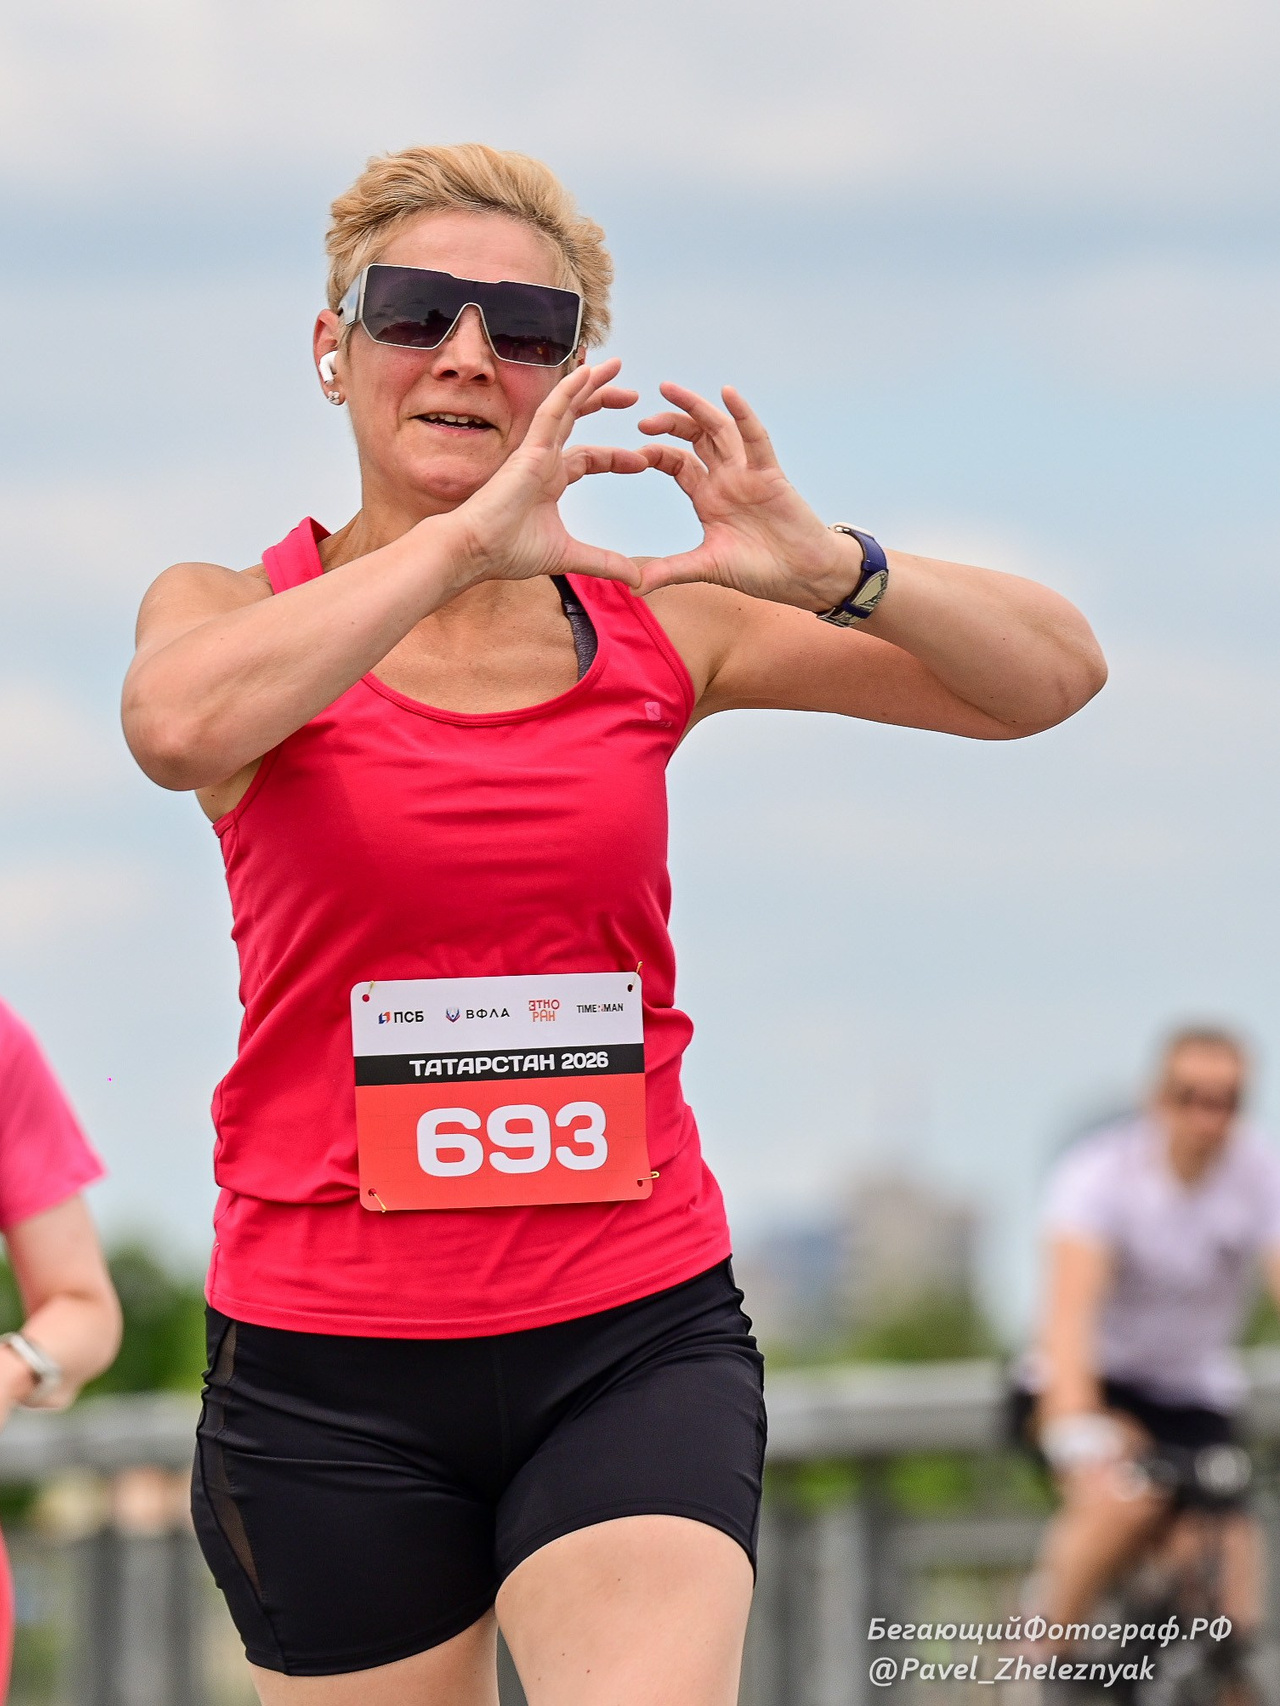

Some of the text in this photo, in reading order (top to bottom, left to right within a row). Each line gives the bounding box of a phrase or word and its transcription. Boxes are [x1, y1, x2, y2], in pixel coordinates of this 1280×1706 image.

[393, 1010, 424, 1024] ПСБ
[465, 1007, 510, 1020] ВФЛА
[409, 1051, 609, 1077] ТАТАРСТАН 2026
[416, 1101, 609, 1177] 693
